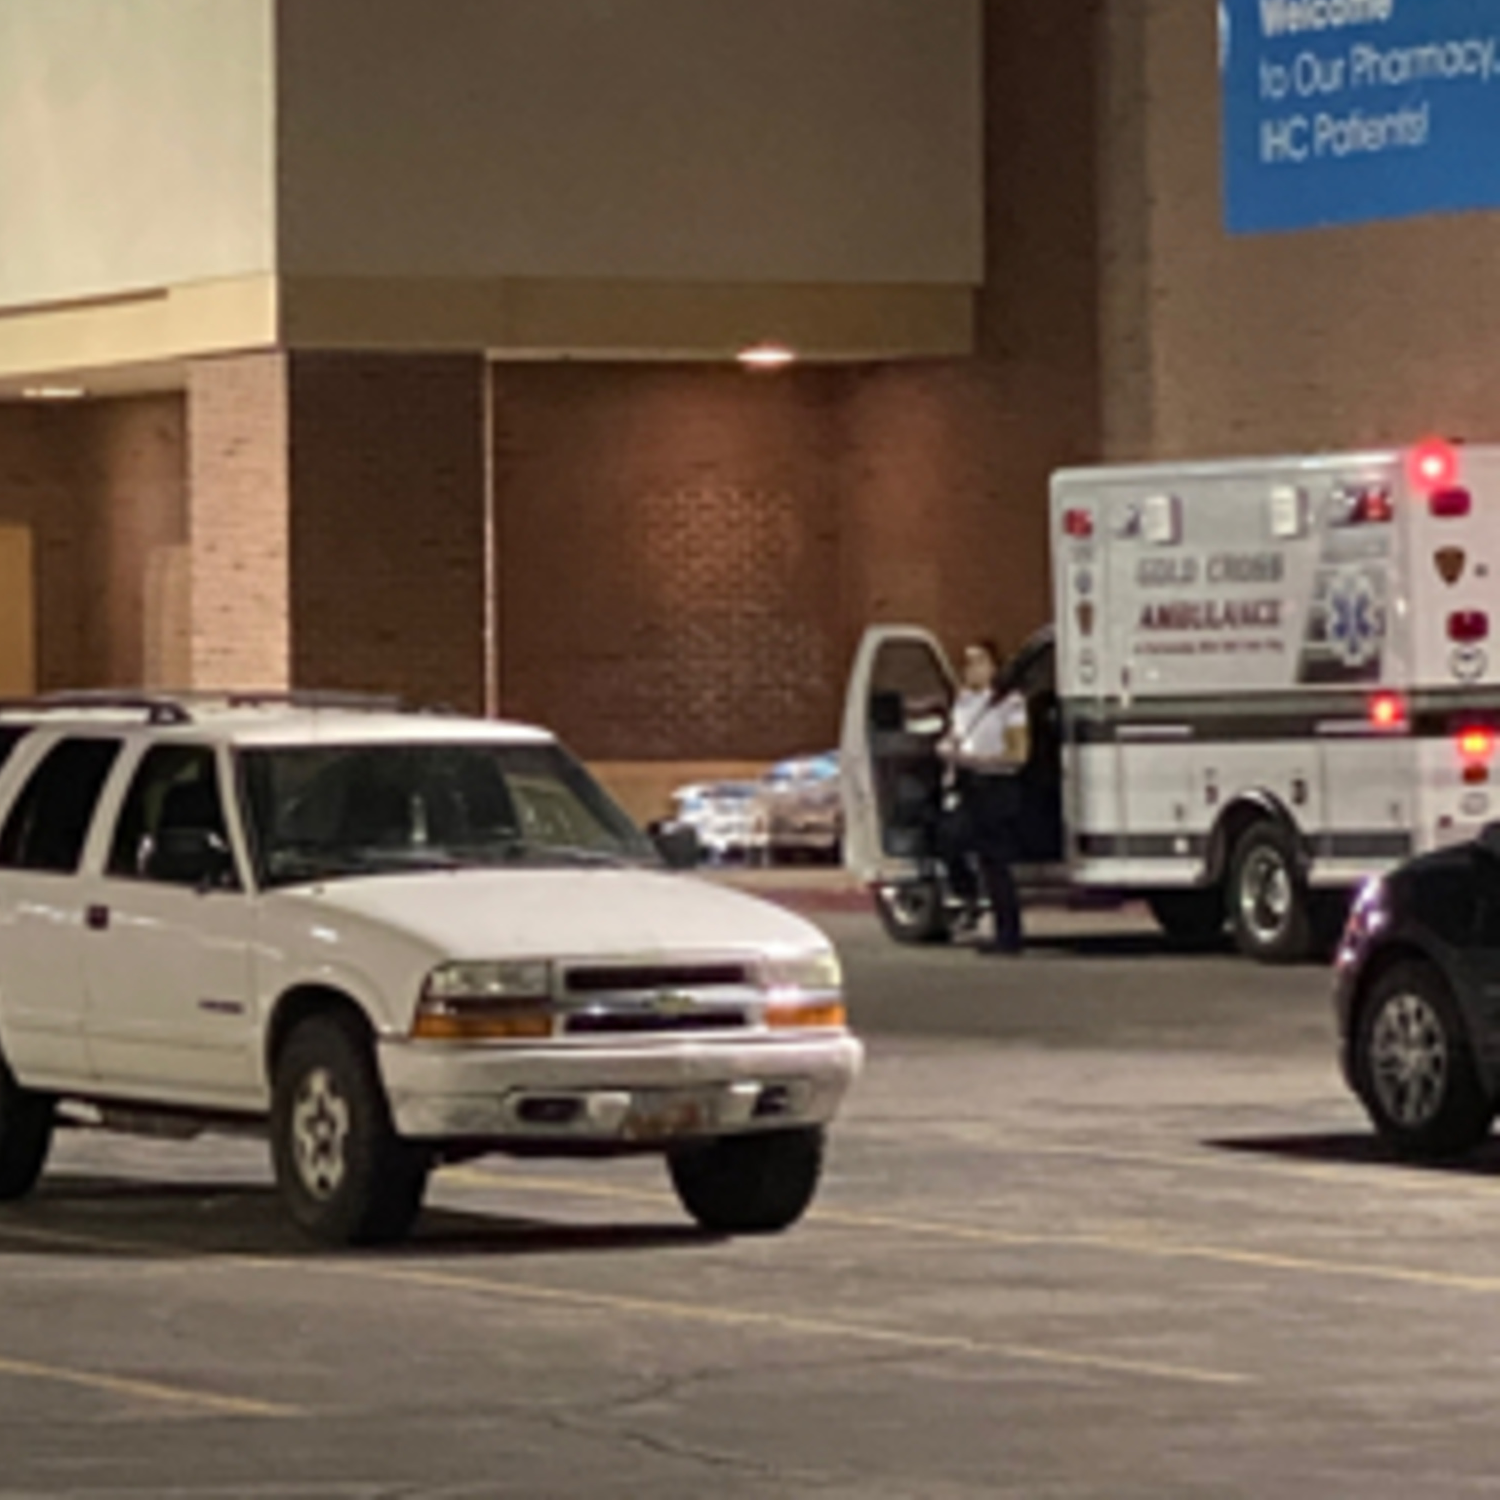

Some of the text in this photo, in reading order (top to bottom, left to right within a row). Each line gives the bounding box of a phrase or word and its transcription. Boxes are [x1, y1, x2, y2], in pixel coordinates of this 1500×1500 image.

[1259, 57, 1288, 98] to
[1294, 52, 1345, 97] Our
[1136, 556, 1196, 587] GOLD
[1138, 600, 1281, 630] AMBULANCE
